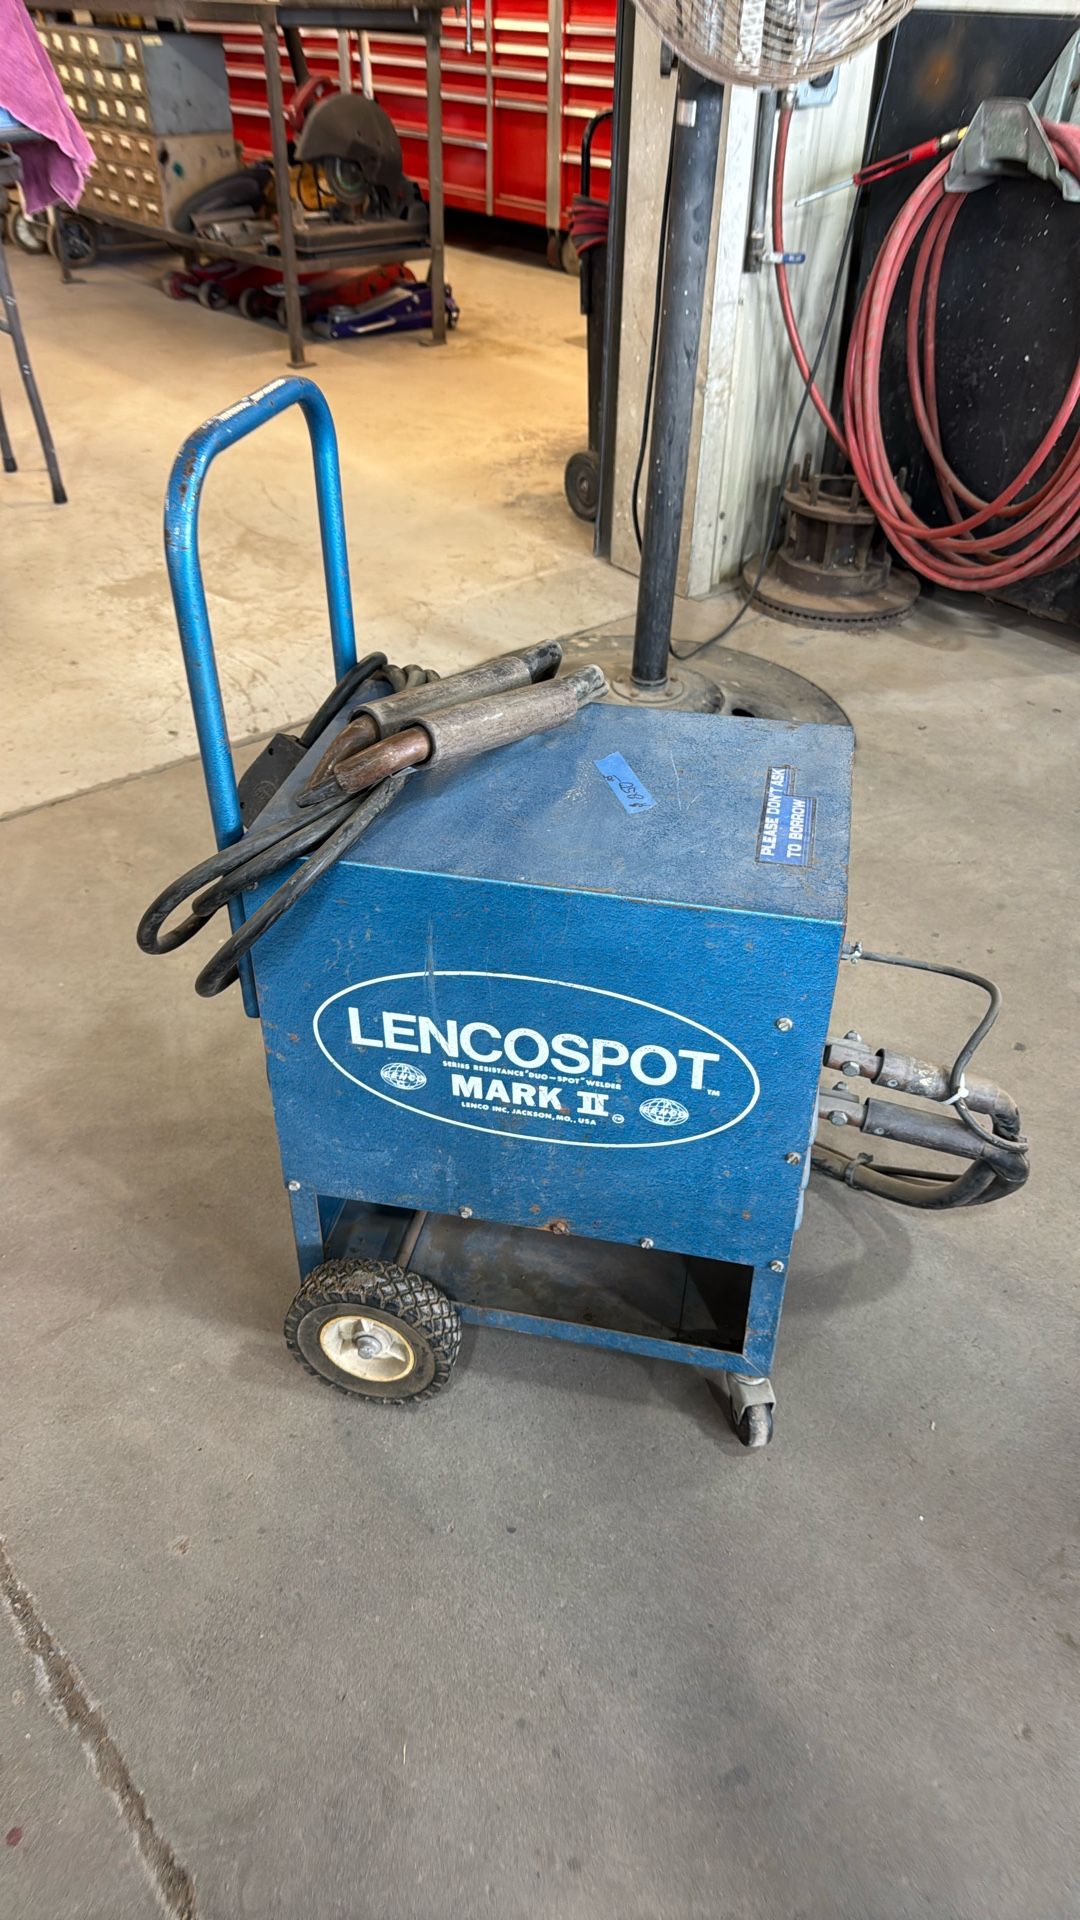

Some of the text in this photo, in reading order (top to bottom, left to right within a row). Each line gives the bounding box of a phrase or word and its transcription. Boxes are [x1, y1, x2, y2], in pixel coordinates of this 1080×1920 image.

[760, 817, 780, 856] PLEASE
[770, 767, 786, 788] ASK
[786, 799, 806, 858] TO BORROW
[347, 1007, 720, 1091] LENCOSPOT
[442, 1060, 471, 1070] SERIES
[472, 1064, 524, 1077] RESISTANCE
[585, 1079, 622, 1090] WELDER
[451, 1073, 563, 1111] MARK
[576, 1090, 609, 1117] II
[461, 1101, 490, 1111] LENCO
[491, 1105, 510, 1114] INC.
[577, 1117, 597, 1126] USA
